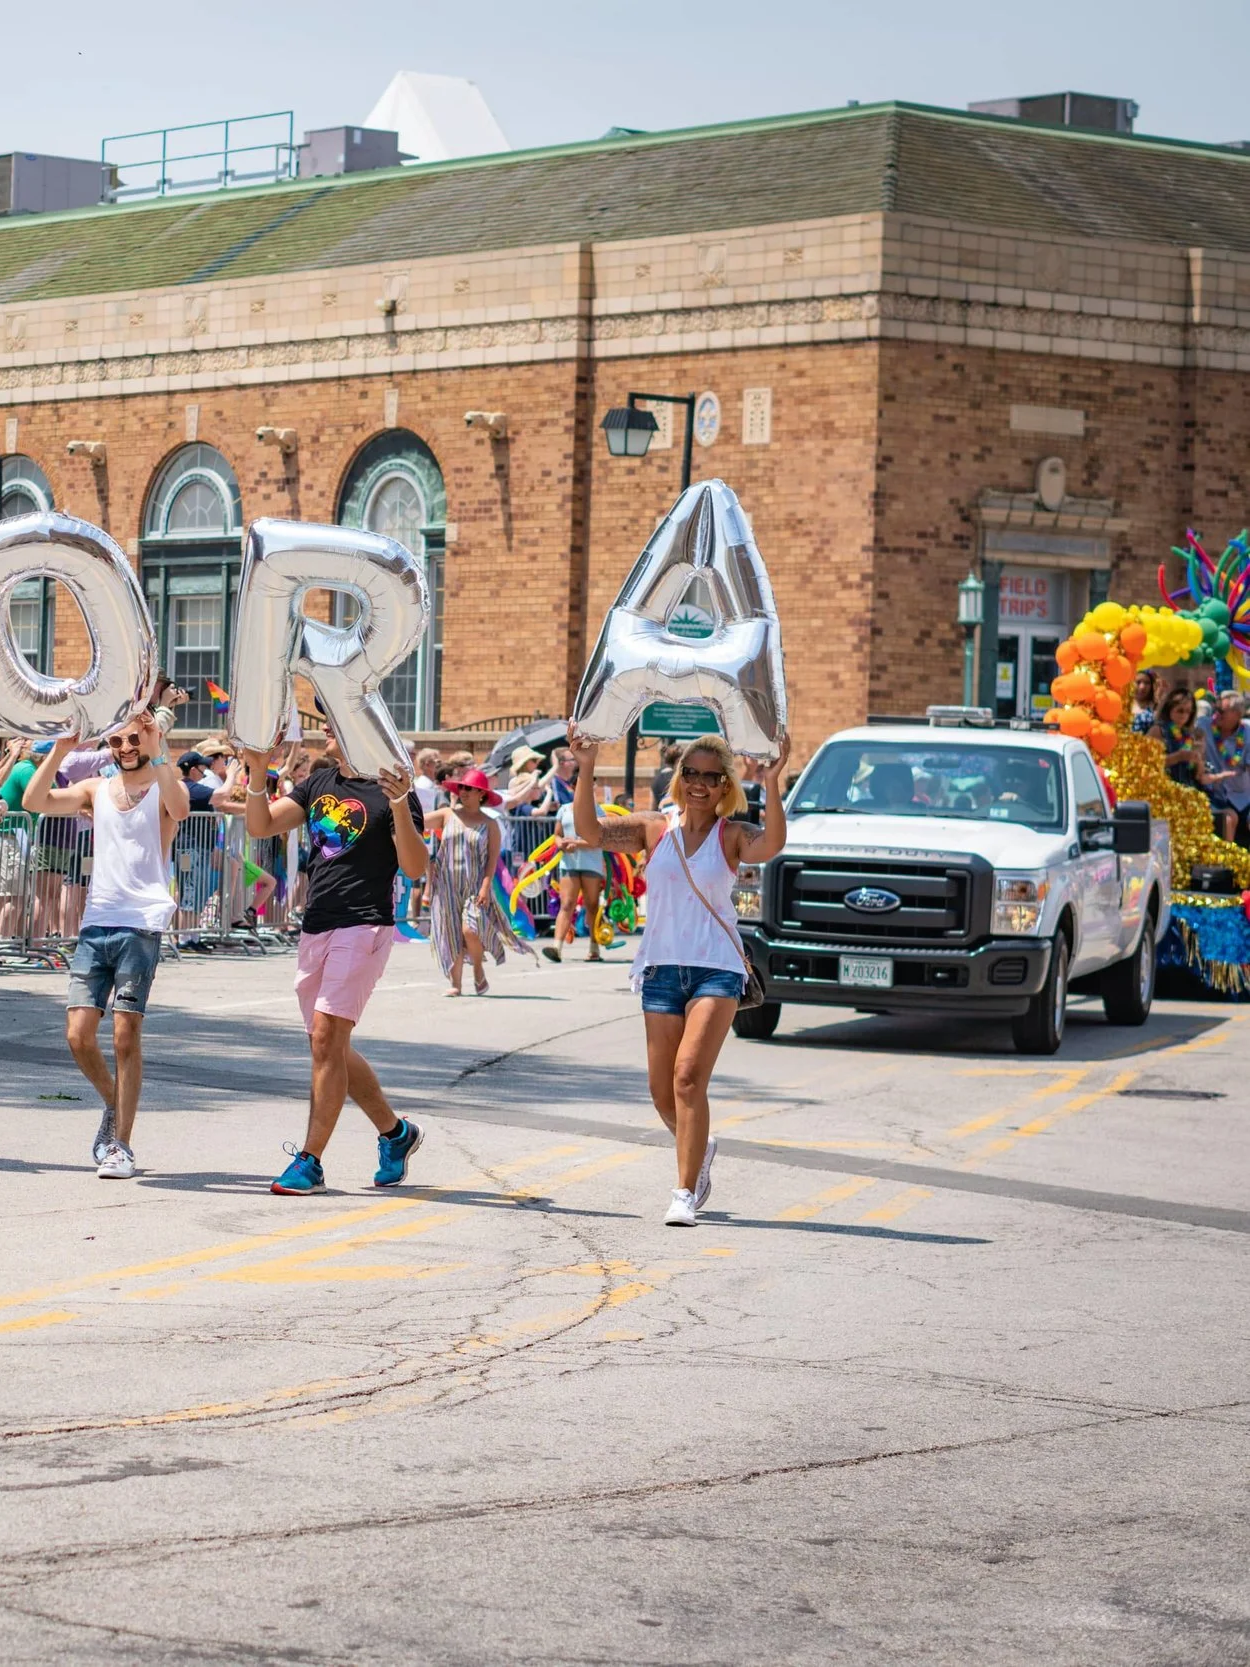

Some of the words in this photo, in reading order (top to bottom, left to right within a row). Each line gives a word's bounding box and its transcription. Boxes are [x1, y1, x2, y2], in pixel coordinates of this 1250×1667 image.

[1000, 576, 1048, 596] FIELD
[1000, 595, 1048, 618] TRIPS
[855, 892, 888, 908] Ford
